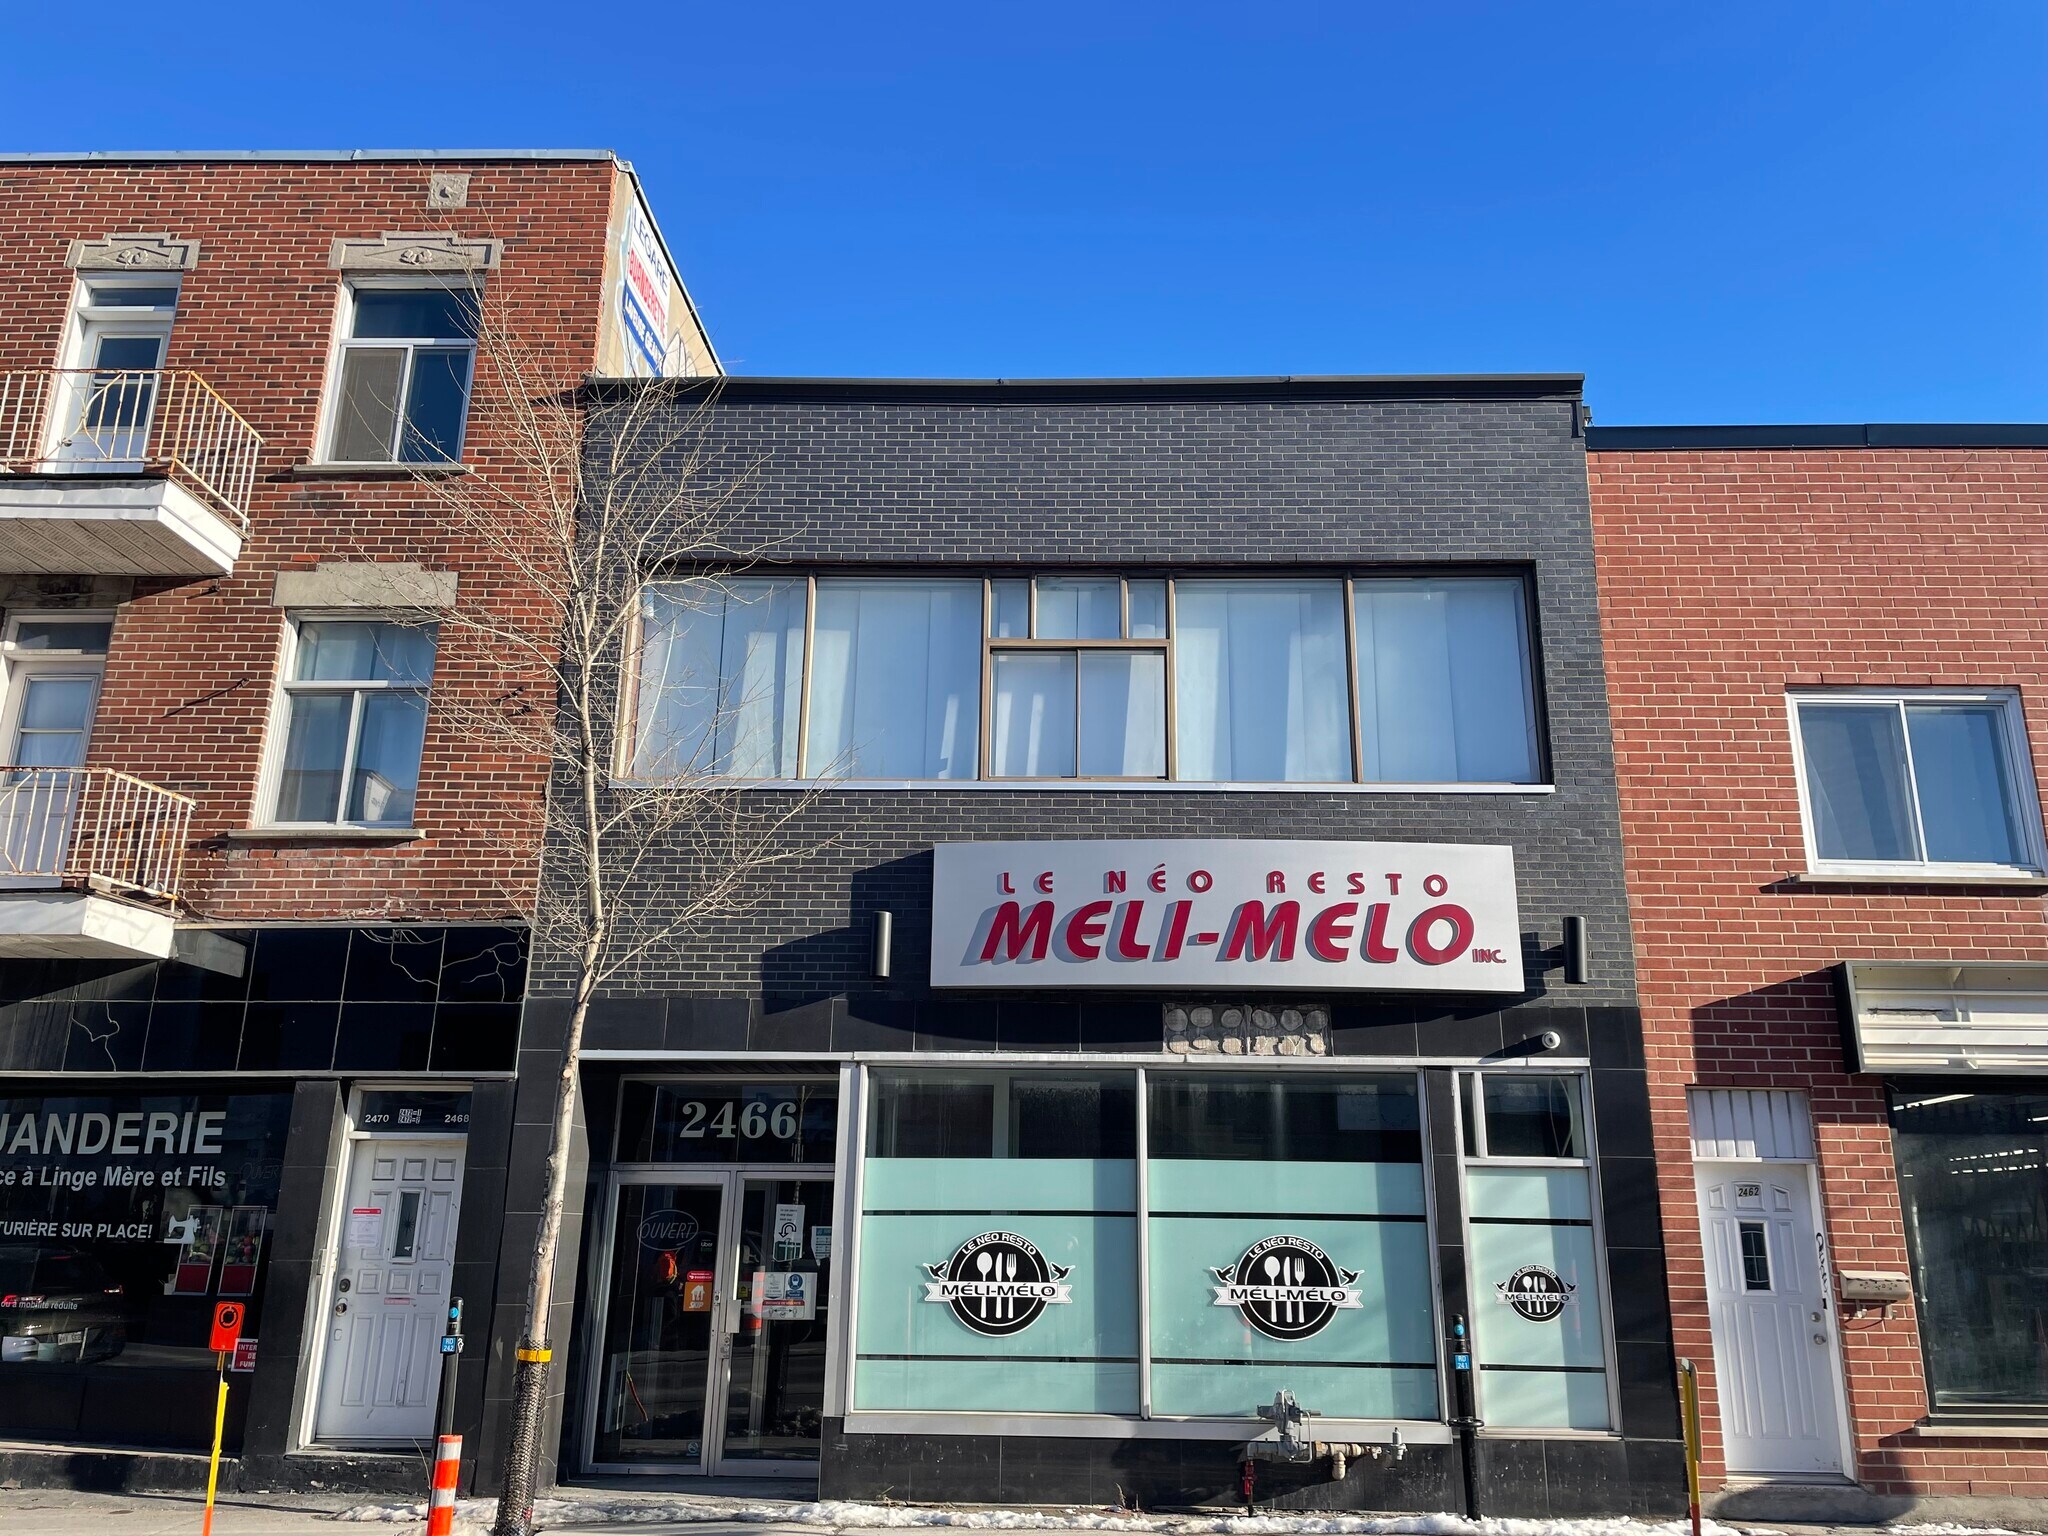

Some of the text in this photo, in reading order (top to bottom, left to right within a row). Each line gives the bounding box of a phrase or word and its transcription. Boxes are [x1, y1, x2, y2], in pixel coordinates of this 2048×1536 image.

[1001, 862, 1449, 897] LE NÉO RESTO
[980, 899, 1507, 965] MELI-MELO INC.
[364, 1114, 390, 1123] 2470
[444, 1114, 470, 1123] 2468
[679, 1101, 798, 1139] 2466
[21, 1166, 34, 1186] à
[39, 1165, 97, 1192] Linge
[103, 1165, 155, 1187] Mère
[160, 1167, 183, 1187] et
[187, 1165, 226, 1187] Fils
[1738, 1187, 1760, 1197] 2462
[61, 1223, 94, 1238] SUR
[96, 1223, 154, 1239] PLACE!
[641, 1222, 696, 1239] OUVERT
[962, 1232, 1037, 1256] LE NÉO RESTO
[1248, 1236, 1324, 1260] LE NÉO RESTO
[941, 1282, 1056, 1297] MÉLI-MÉLO
[1230, 1286, 1346, 1302] MÉLI-MÉLO
